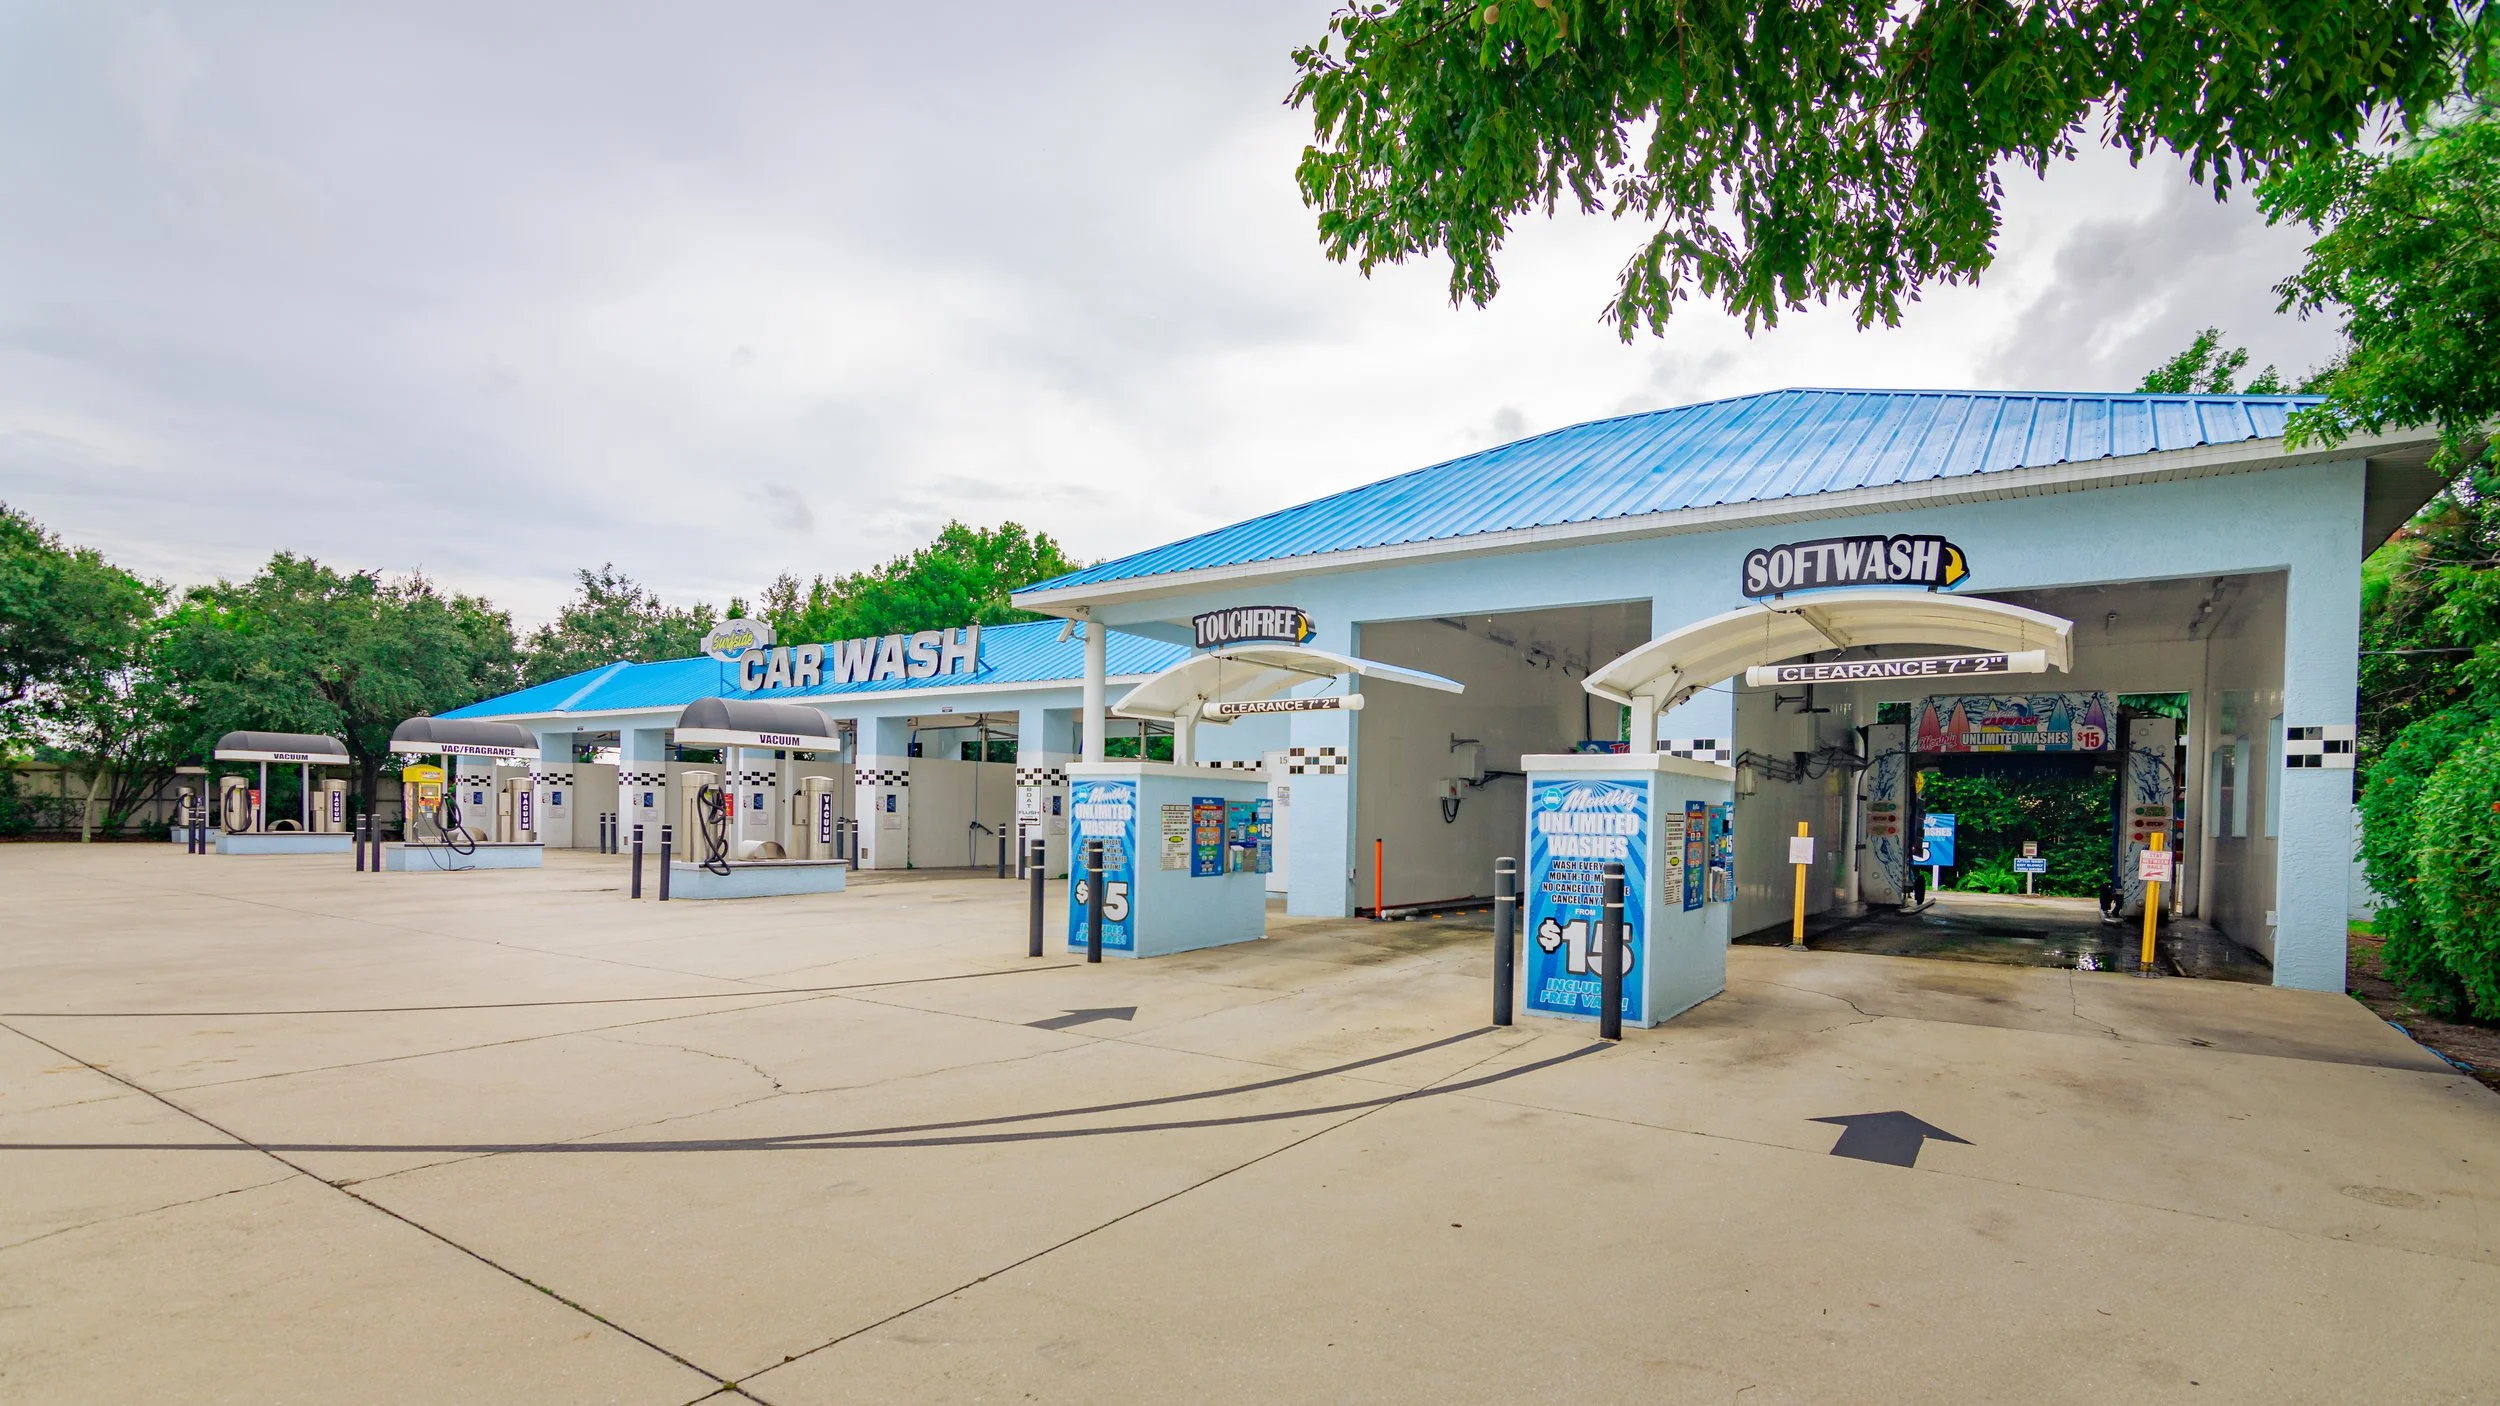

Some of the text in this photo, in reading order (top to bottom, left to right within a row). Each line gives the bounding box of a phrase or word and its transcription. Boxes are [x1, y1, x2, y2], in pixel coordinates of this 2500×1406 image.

[1747, 540, 1941, 592] SOFTWASH
[1195, 609, 1297, 645] TOUCHFREE
[711, 630, 754, 652] Surfside
[739, 625, 982, 692] CAR WASH
[1782, 660, 1938, 681] CLEARANCE
[1945, 658, 1966, 673] 7'
[1221, 701, 1304, 714] CLEARANCE
[1307, 700, 1319, 710] 7'
[441, 744, 515, 756] VAC/FRAGRANCE
[759, 734, 800, 746] VACUUM
[1962, 733, 2019, 745] UNLIMITED
[2021, 732, 2069, 745] WASHES
[2077, 732, 2100, 748] $15
[1561, 788, 1638, 811] Monthly
[521, 793, 529, 829] VACUUM
[823, 795, 831, 842] VACUUM
[1075, 803, 1132, 820] UNLIMITED
[1080, 820, 1126, 836] WASHES
[1538, 811, 1640, 835] UNLIMITED
[1547, 835, 1629, 858] WASHES
[1552, 860, 1604, 871] WASH EVERY
[1543, 882, 1603, 894] NO CANCELLATI
[1075, 879, 1129, 922] $5
[1551, 895, 1580, 904] CANCEL
[1575, 908, 1596, 916] FROM
[1537, 917, 1635, 978] $15
[1547, 978, 1602, 994] INCLUD
[1540, 990, 1629, 1011] FREE VA!
